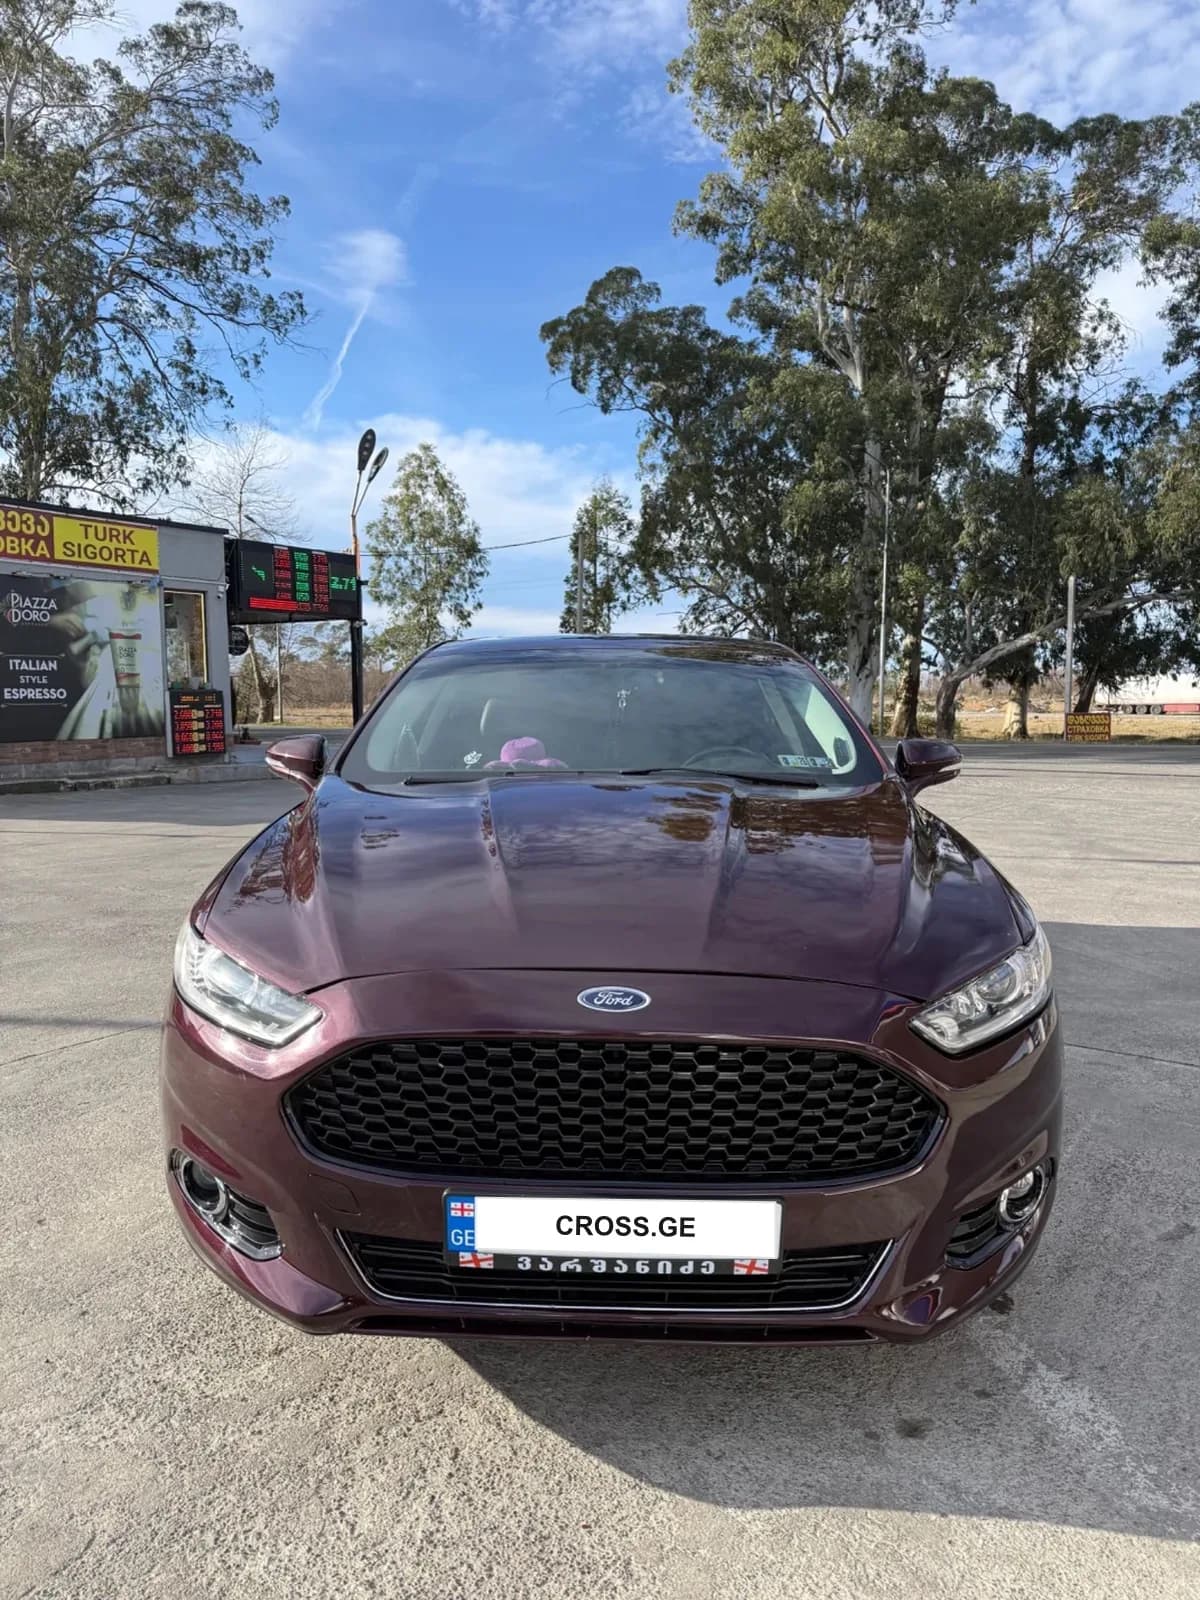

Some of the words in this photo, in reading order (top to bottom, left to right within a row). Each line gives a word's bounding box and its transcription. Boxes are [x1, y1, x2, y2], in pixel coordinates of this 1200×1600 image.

[79, 523, 135, 545] TURK
[62, 541, 152, 566] SIGORTA
[10, 592, 58, 610] PIAZZA
[9, 659, 57, 671] ITALIAN
[19, 675, 48, 684] STYLE
[3, 688, 67, 700] ESPRESSO
[593, 991, 633, 1006] Ford
[451, 1229, 475, 1246] GE
[517, 1255, 715, 1275] ვარშანიძე
